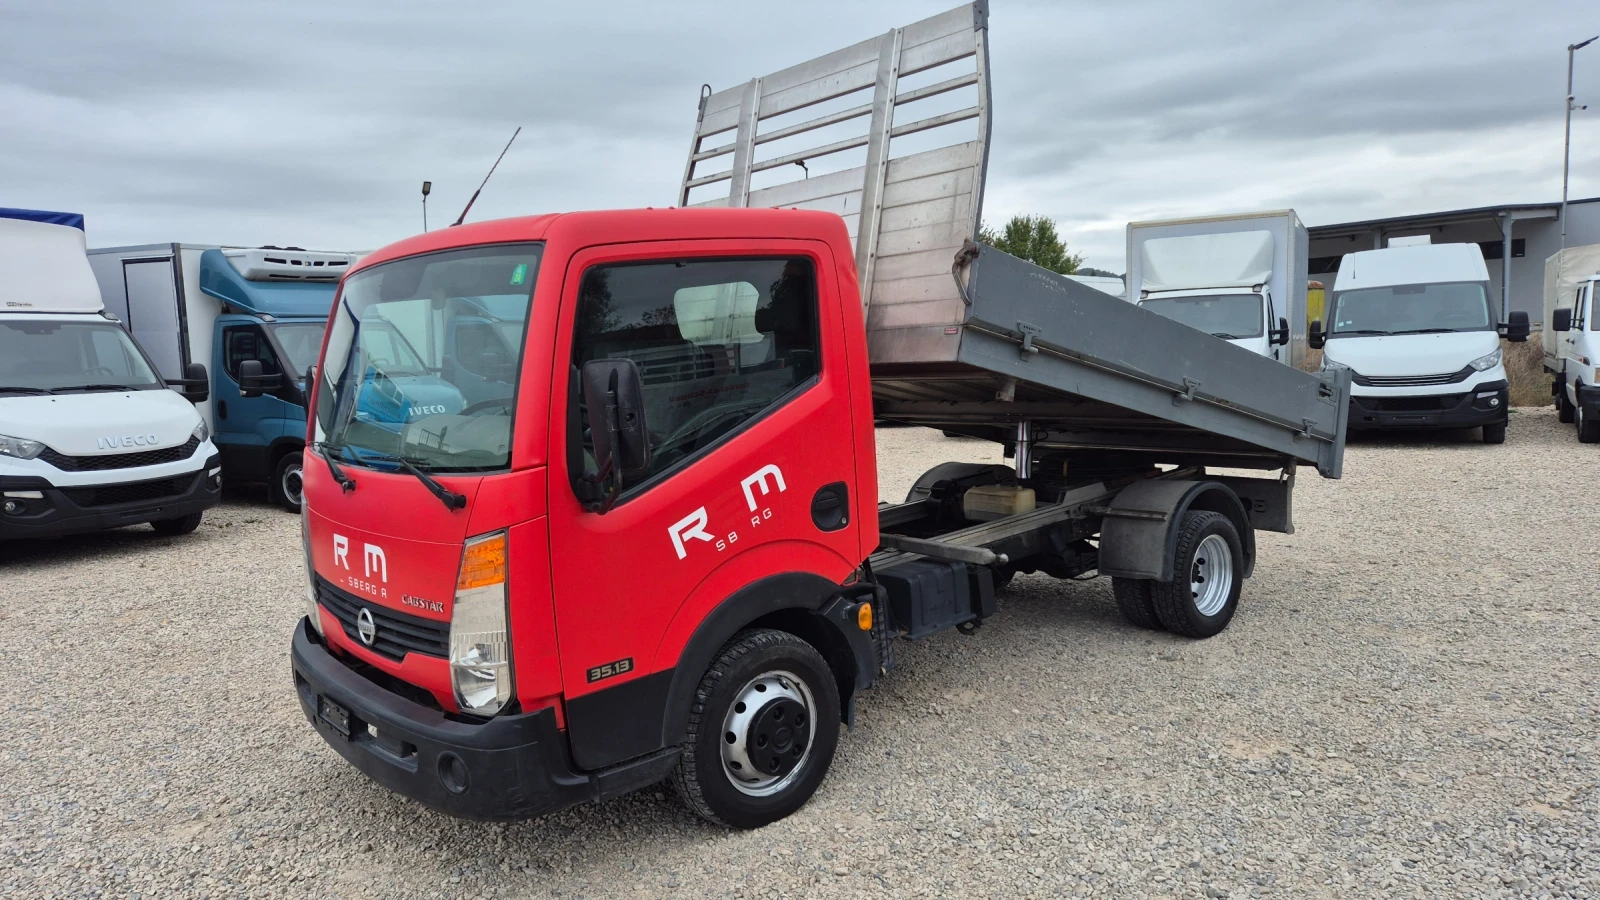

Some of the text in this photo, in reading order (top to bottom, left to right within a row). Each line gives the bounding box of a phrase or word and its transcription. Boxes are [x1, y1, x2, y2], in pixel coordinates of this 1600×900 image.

[408, 404, 446, 416] IVECO
[96, 433, 160, 450] IVECO
[667, 505, 716, 560] R
[333, 533, 350, 571] R
[401, 594, 445, 613] CABSTAR
[590, 659, 630, 681] 35.13
